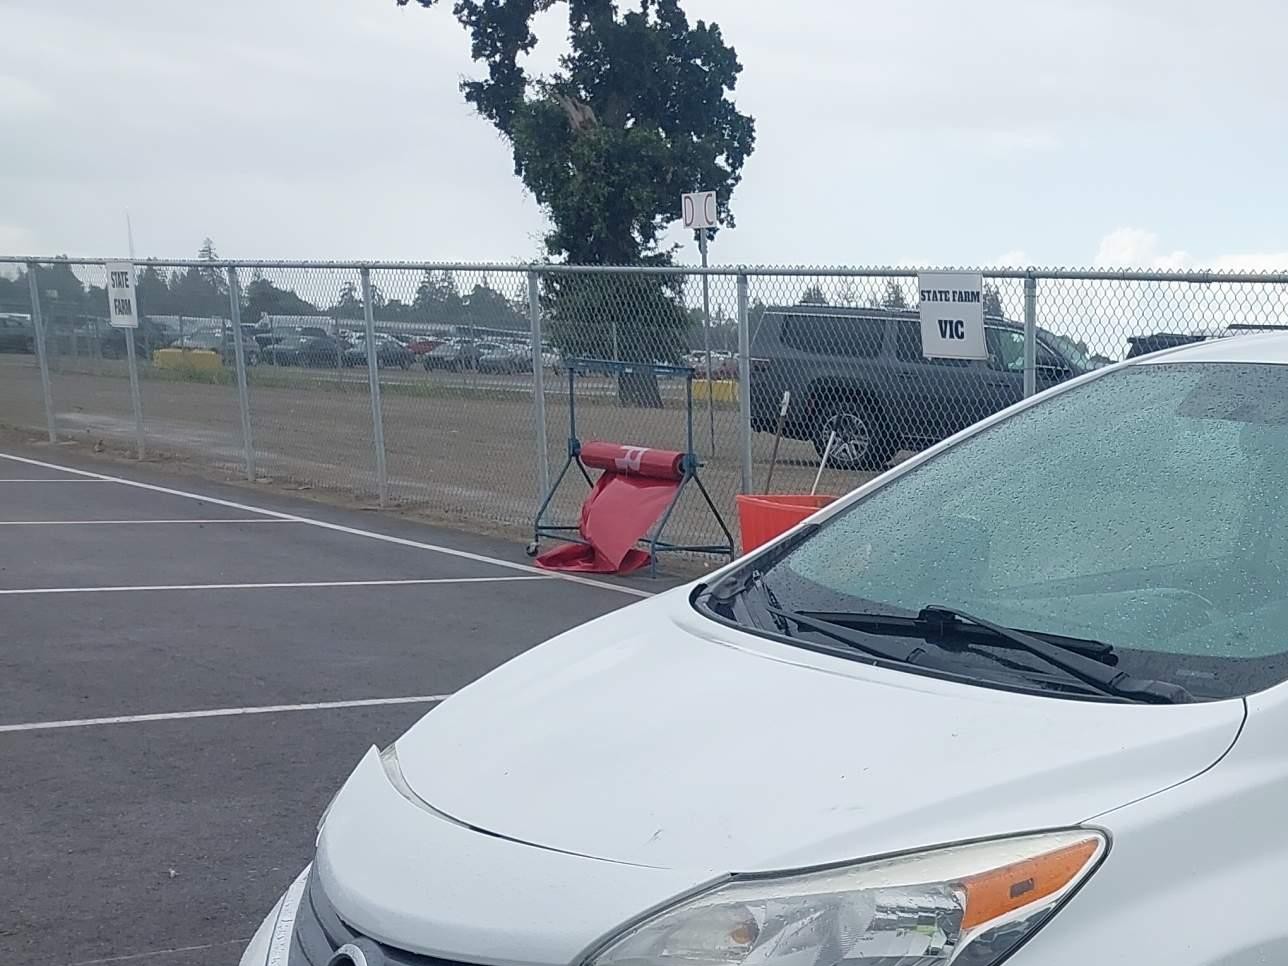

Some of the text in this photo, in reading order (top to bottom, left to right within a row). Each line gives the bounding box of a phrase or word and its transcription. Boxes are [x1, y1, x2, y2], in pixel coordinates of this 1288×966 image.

[111, 271, 129, 289] STATE
[920, 290, 980, 303] STATE FARM
[938, 319, 965, 340] VIC
